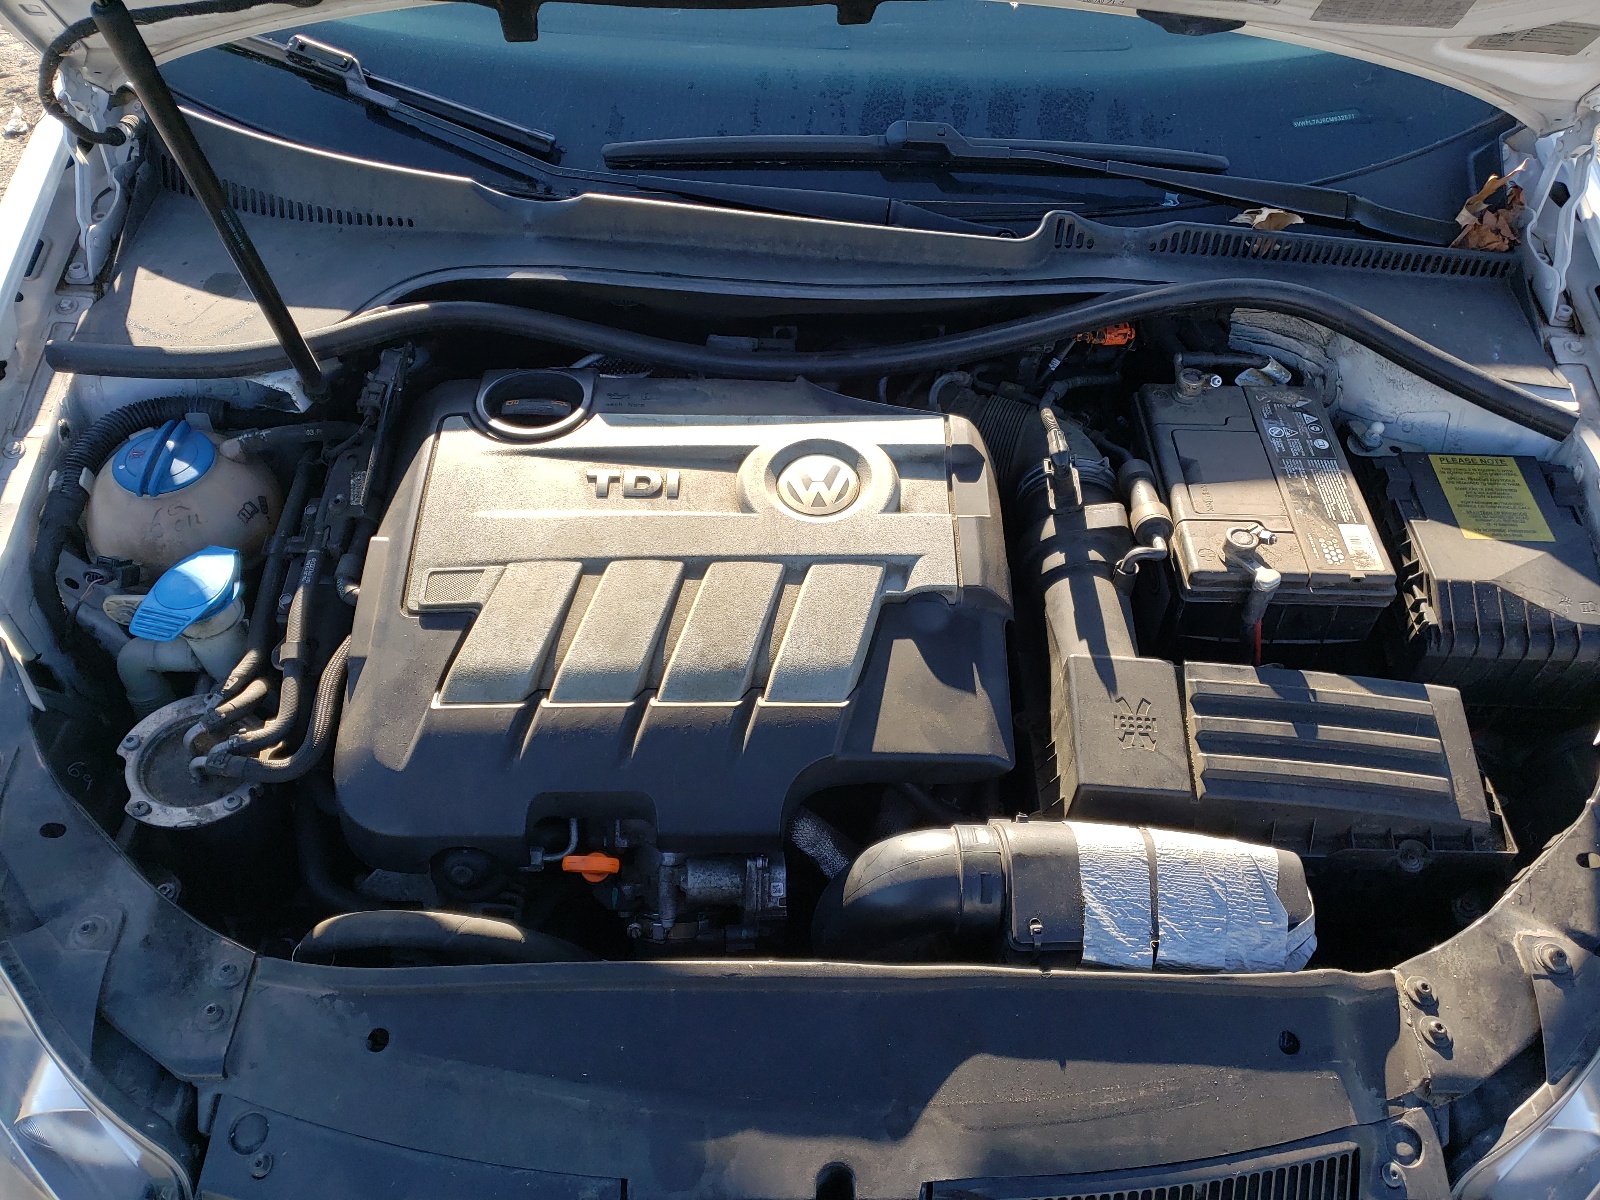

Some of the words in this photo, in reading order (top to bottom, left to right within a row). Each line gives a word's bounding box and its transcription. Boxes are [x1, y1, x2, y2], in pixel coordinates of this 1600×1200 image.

[1439, 457, 1478, 465] PLEASE
[1479, 458, 1507, 466] NOTE
[586, 469, 680, 500] TDI
